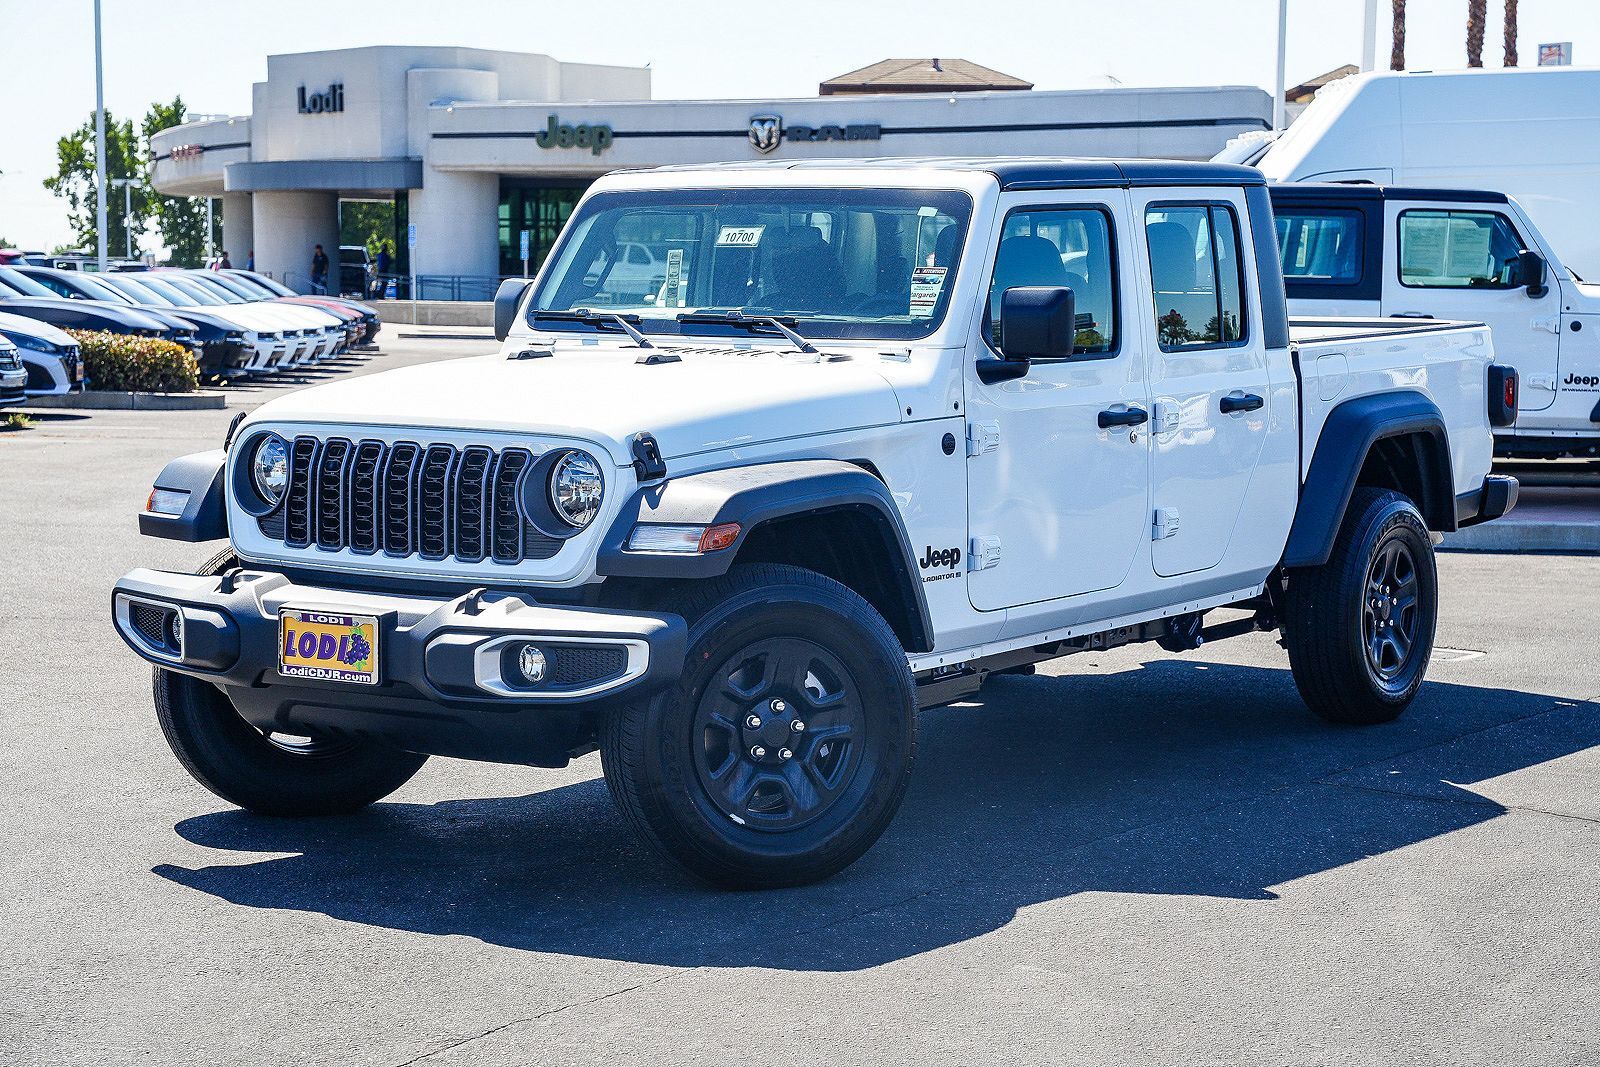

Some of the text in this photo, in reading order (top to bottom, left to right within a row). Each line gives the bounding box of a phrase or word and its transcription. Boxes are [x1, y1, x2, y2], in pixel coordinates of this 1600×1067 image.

[298, 84, 344, 113] Lodi
[536, 115, 612, 156] Jeep
[787, 125, 881, 141] RAM
[725, 232, 755, 243] 10700
[1564, 373, 1599, 387] Jeep
[920, 546, 961, 569] Jeep
[921, 572, 955, 583] LADIATOR
[309, 615, 345, 625] LODI
[285, 630, 350, 661] LODI
[283, 665, 371, 682] LodiCDJR.com
